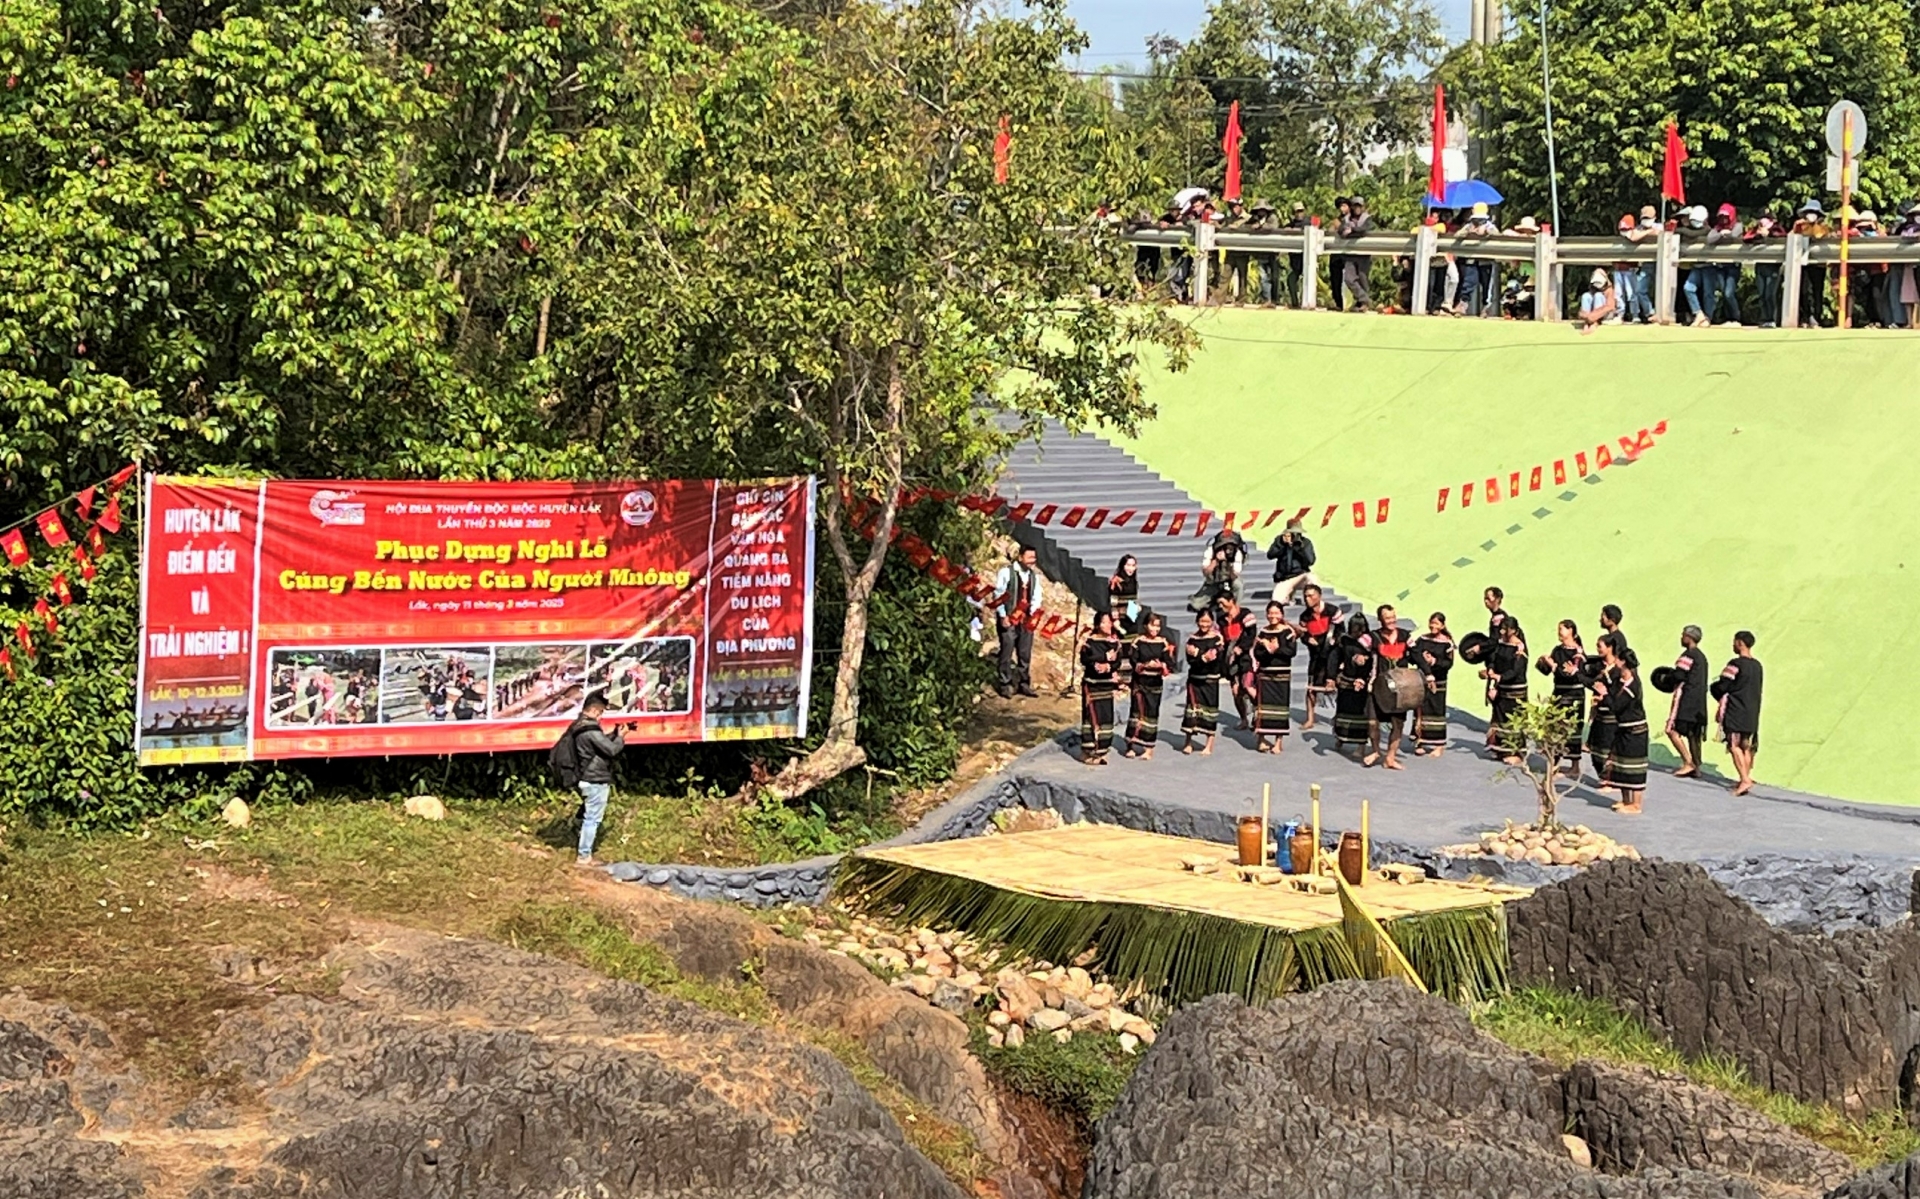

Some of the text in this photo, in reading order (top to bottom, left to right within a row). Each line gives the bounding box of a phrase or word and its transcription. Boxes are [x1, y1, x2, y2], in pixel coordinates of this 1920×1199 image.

[165, 503, 211, 538] HUYỆN
[168, 540, 236, 575] ĐIỂM ĐẾN
[375, 540, 440, 563] Phục
[445, 540, 512, 563] Dựng
[517, 540, 574, 563] Nghi
[279, 569, 348, 594] Cúng
[352, 568, 402, 590] Bến
[408, 570, 472, 590] Nước
[478, 569, 526, 589] Của
[532, 569, 603, 592] Người
[191, 585, 210, 615] VÀ
[731, 594, 781, 612] DU LỊCH
[742, 612, 770, 631] CỦA
[149, 624, 181, 658] TRẢI
[184, 625, 240, 660] NGHIỆM
[716, 636, 796, 656] ĐỊA PHƯƠNG
